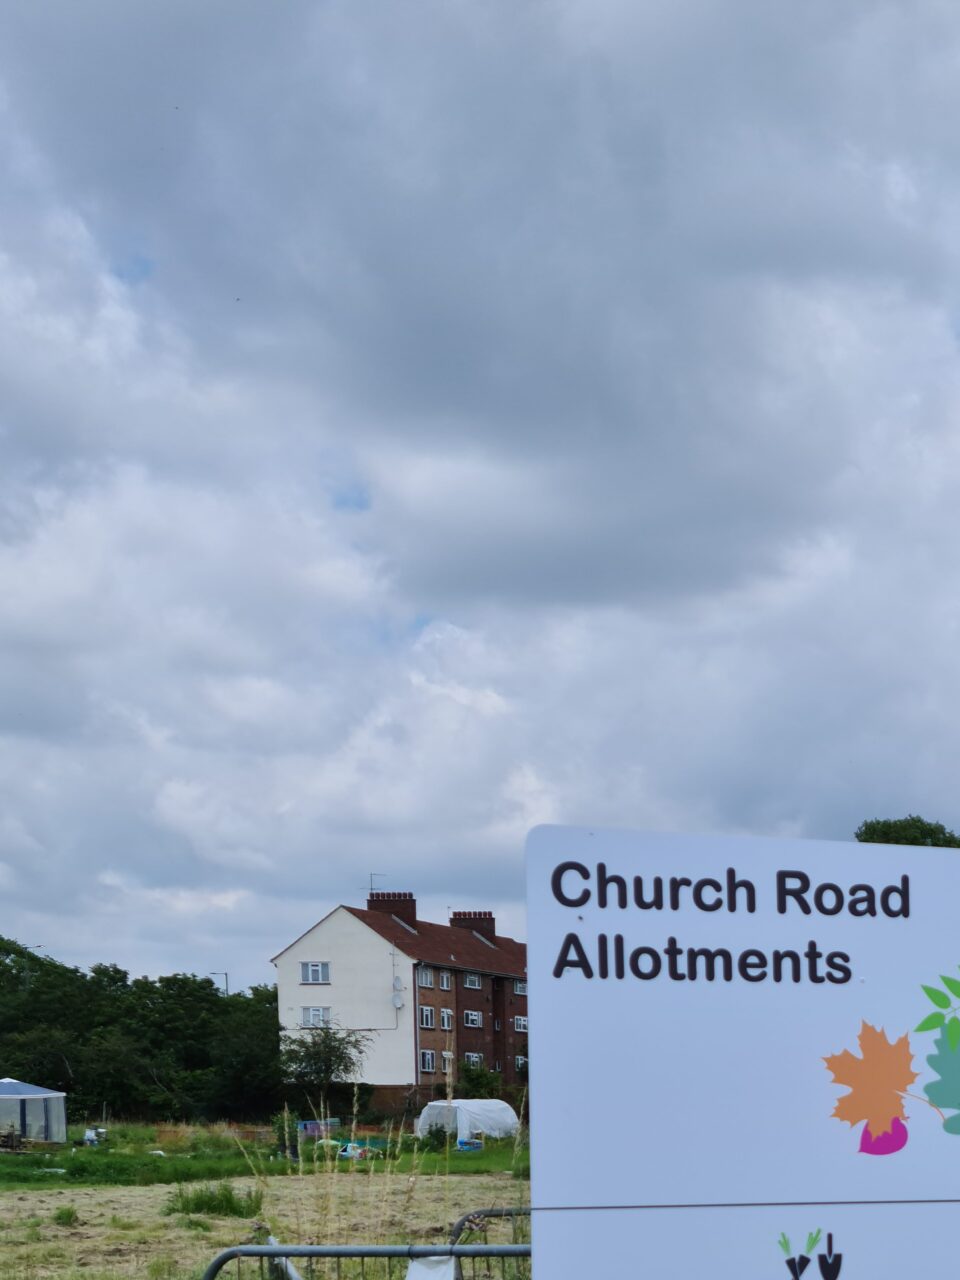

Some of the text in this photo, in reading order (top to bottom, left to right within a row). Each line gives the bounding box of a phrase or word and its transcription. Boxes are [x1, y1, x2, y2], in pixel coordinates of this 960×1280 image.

[551, 861, 910, 918] Church Road
[552, 932, 852, 984] Allotments
